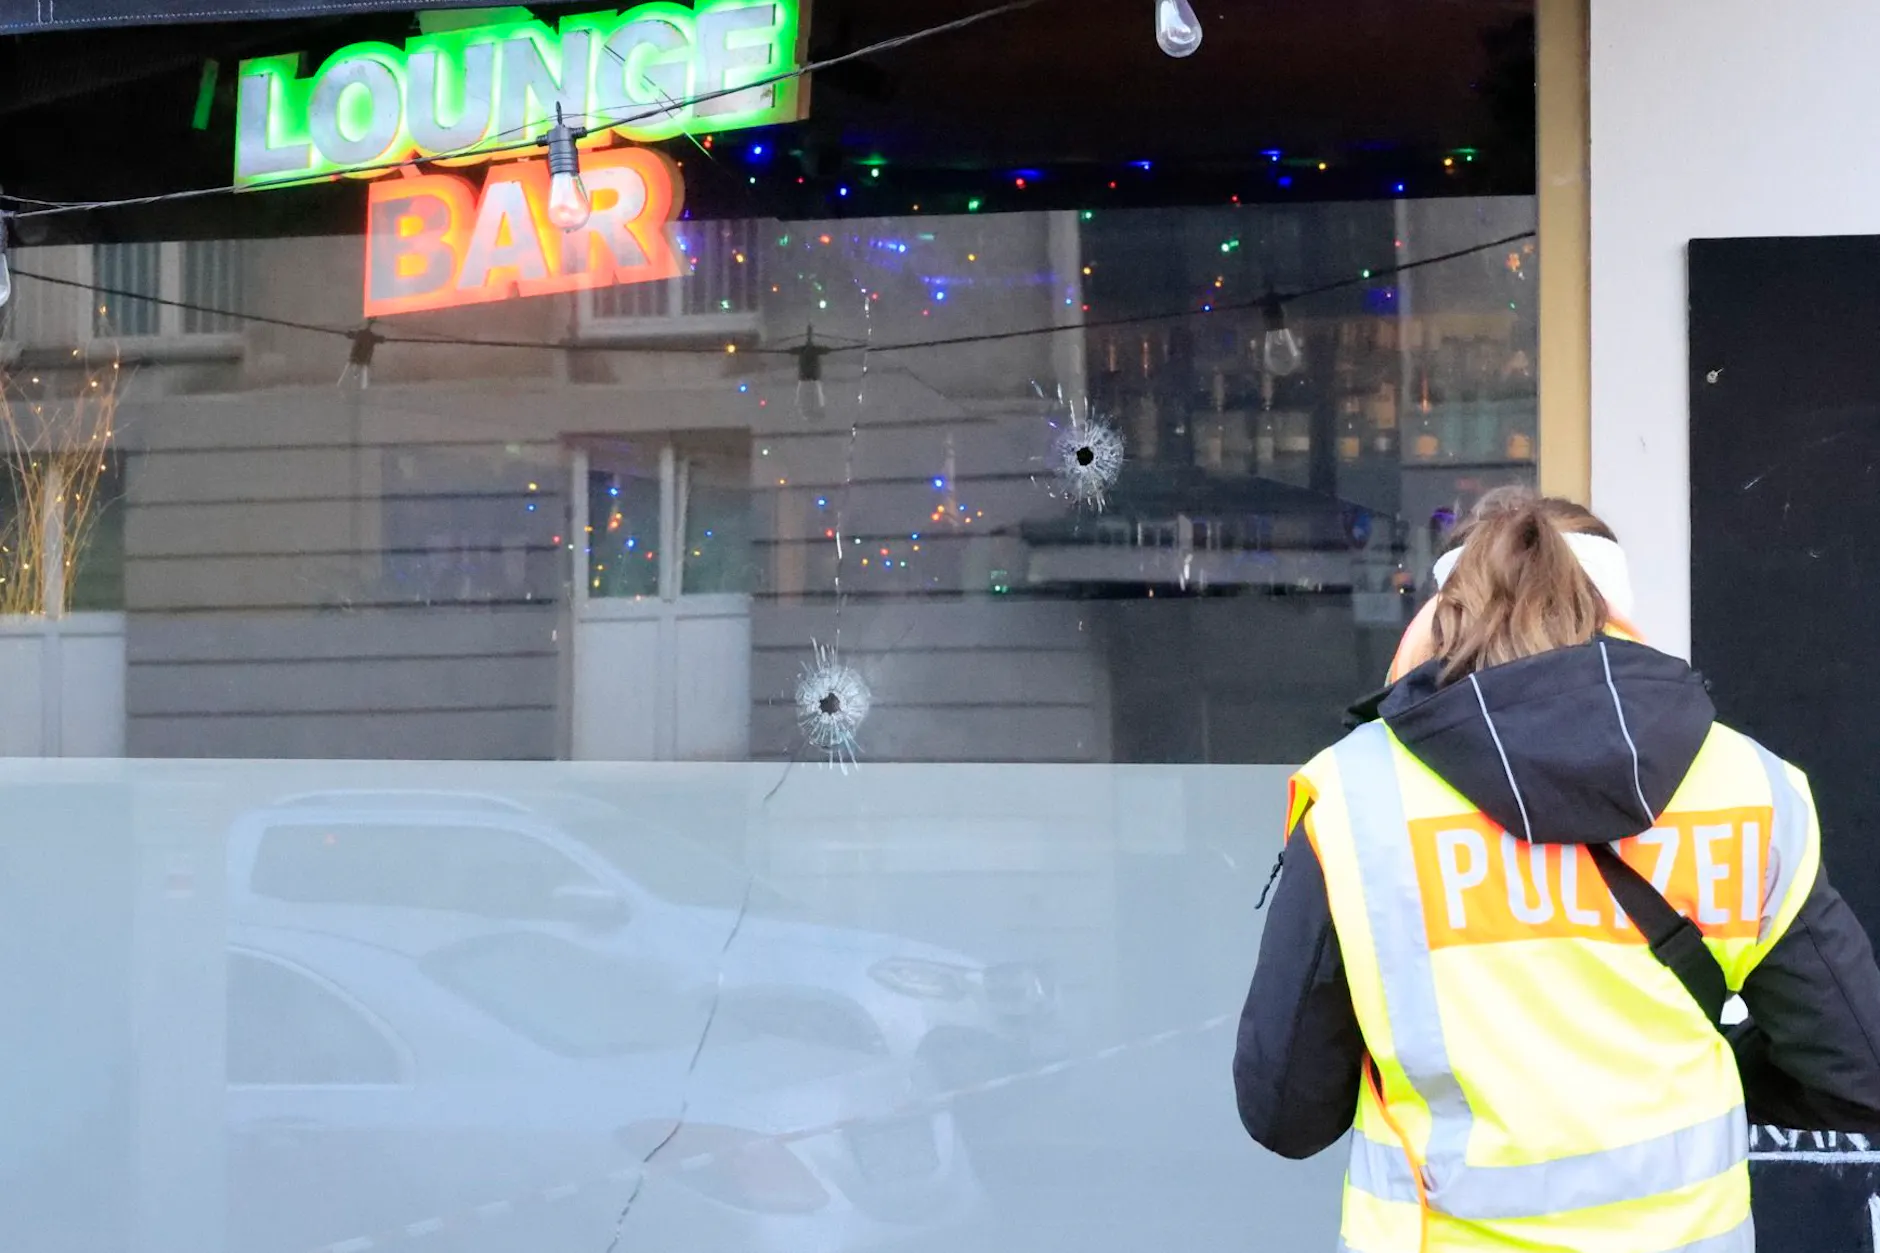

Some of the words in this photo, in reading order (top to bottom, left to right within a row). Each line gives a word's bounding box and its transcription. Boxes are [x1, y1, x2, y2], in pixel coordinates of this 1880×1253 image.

[235, 1, 779, 178] LOUNGE
[367, 164, 651, 302] BAR
[1435, 821, 1760, 929] POLZEI
